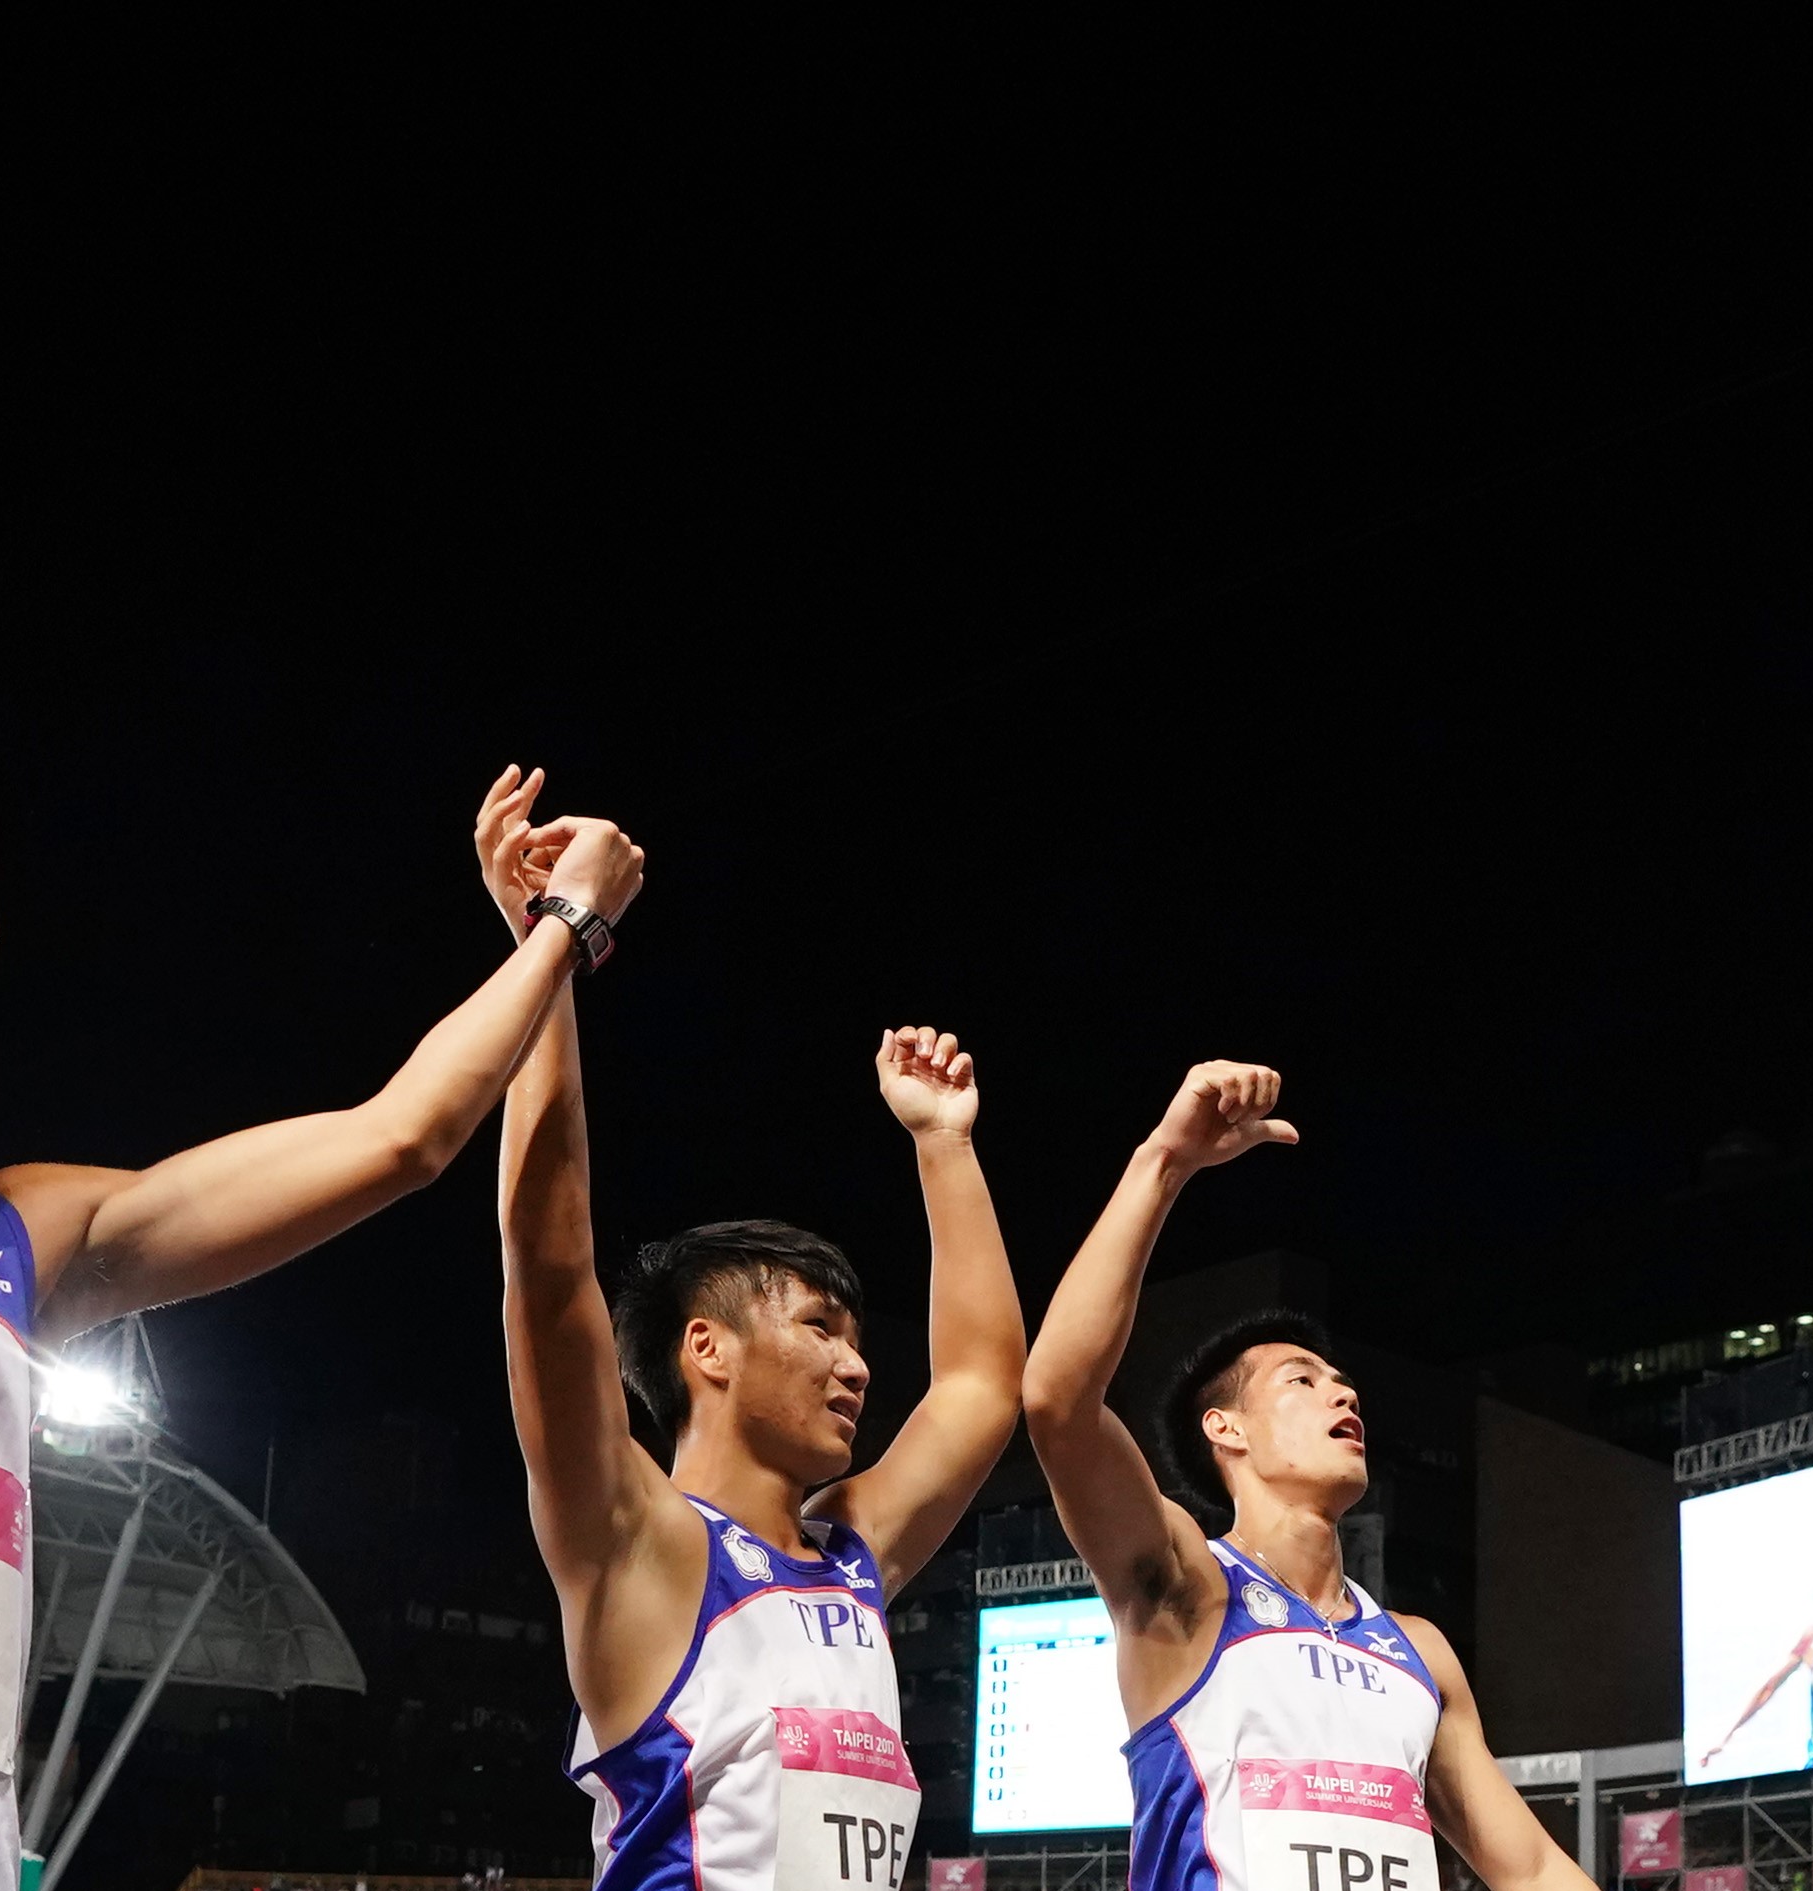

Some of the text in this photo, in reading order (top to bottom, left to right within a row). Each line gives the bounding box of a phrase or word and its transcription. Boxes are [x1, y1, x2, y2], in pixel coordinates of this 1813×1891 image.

[789, 1598, 875, 1650] TPE
[1298, 1643, 1387, 1695] TPE
[832, 1728, 895, 1756] TAIPEI 2017
[1303, 1774, 1393, 1799] TAIPEI 2017
[1305, 1790, 1344, 1804] SUMMER
[823, 1812, 905, 1890] TPE
